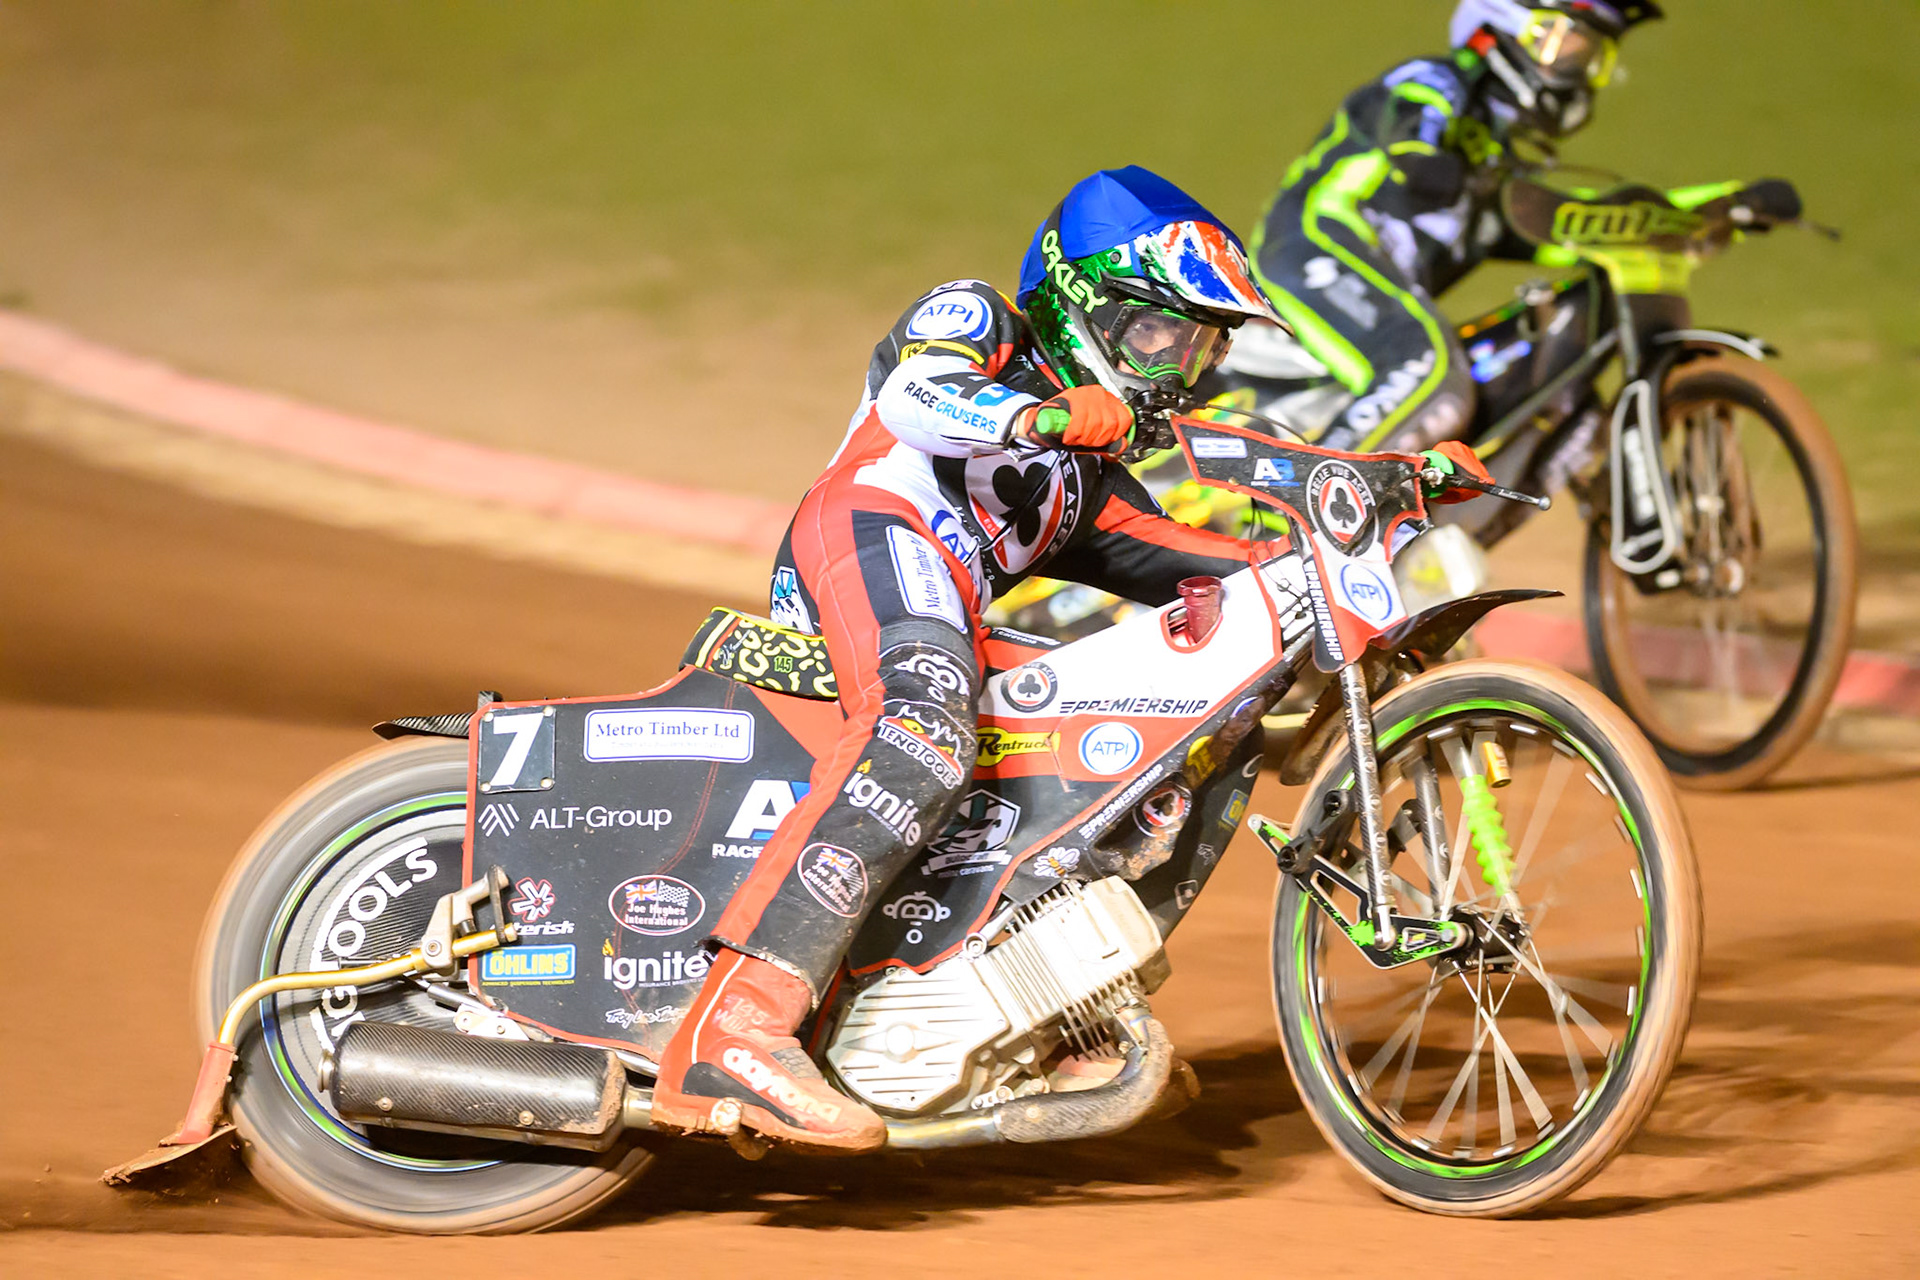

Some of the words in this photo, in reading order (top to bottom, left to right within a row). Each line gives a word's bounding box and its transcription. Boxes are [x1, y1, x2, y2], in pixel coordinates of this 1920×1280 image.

[1042, 229, 1108, 313] OAKLEY
[917, 303, 974, 323] ATPI
[904, 381, 939, 409] RACE
[935, 401, 998, 435] CRUISERS
[1311, 467, 1331, 496] BELLE
[1351, 477, 1372, 506] ACES
[1049, 491, 1077, 553] ACES
[1351, 582, 1383, 602] ATPI
[774, 656, 793, 673] 145
[595, 724, 643, 738] Metro
[648, 721, 709, 737] Timber
[714, 723, 740, 738] Ltd
[494, 712, 544, 787] 7
[1091, 740, 1130, 757] ATPI
[843, 772, 922, 847] ignite
[1085, 763, 1165, 836] PREMIERSHIP
[530, 806, 673, 831] ALT-Group
[811, 862, 830, 877] Joe
[625, 914, 689, 926] International
[627, 903, 647, 914] Joe
[649, 904, 686, 917] Hughes
[489, 950, 569, 976] ÖHLINS
[603, 951, 709, 990] ignite
